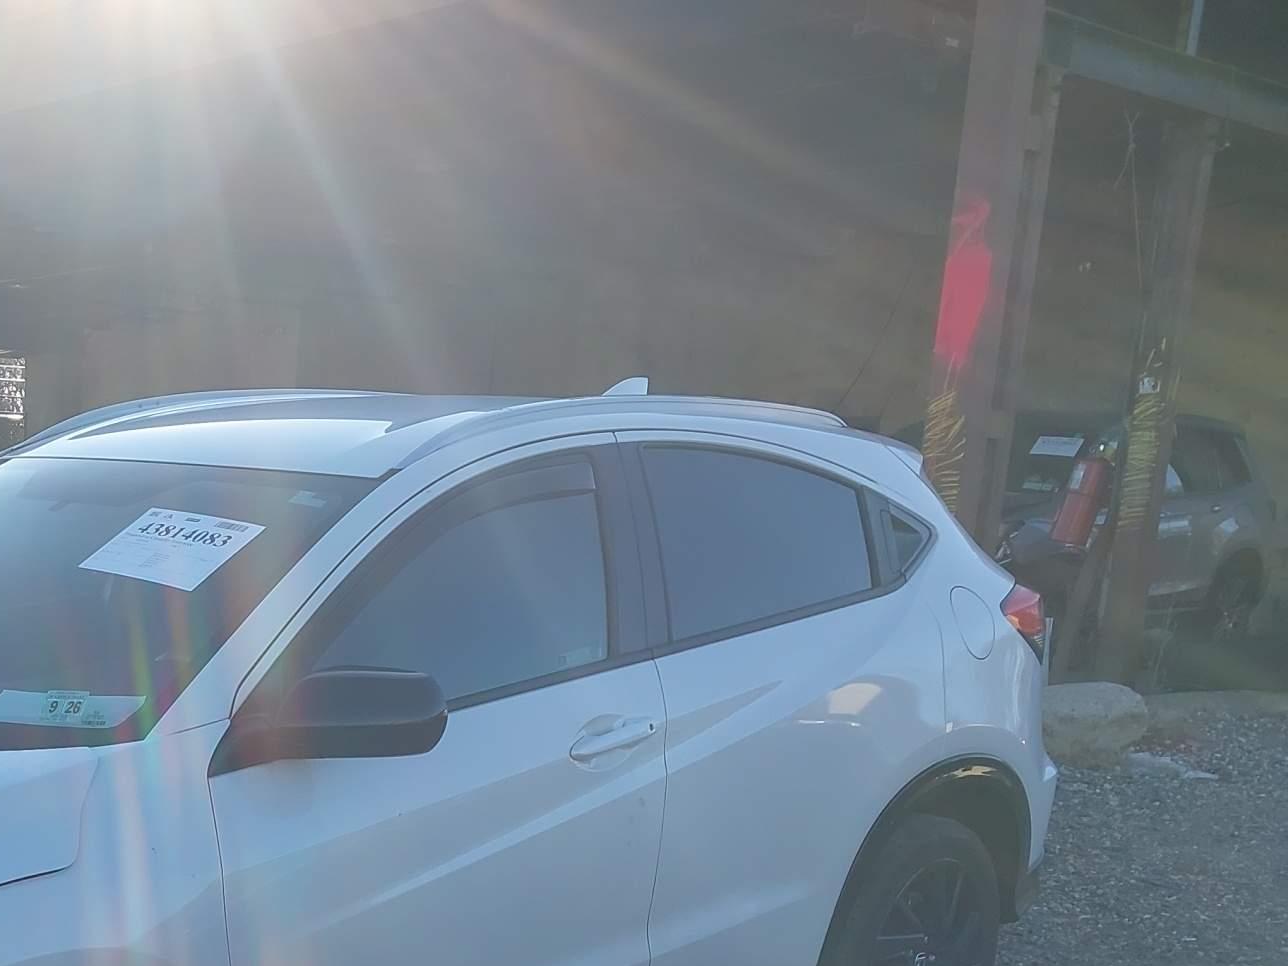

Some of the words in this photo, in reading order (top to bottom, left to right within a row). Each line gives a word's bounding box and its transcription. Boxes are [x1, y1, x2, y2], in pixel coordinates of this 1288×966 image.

[138, 522, 233, 547] 43814083
[48, 701, 59, 713] 9
[64, 701, 82, 713] 26
